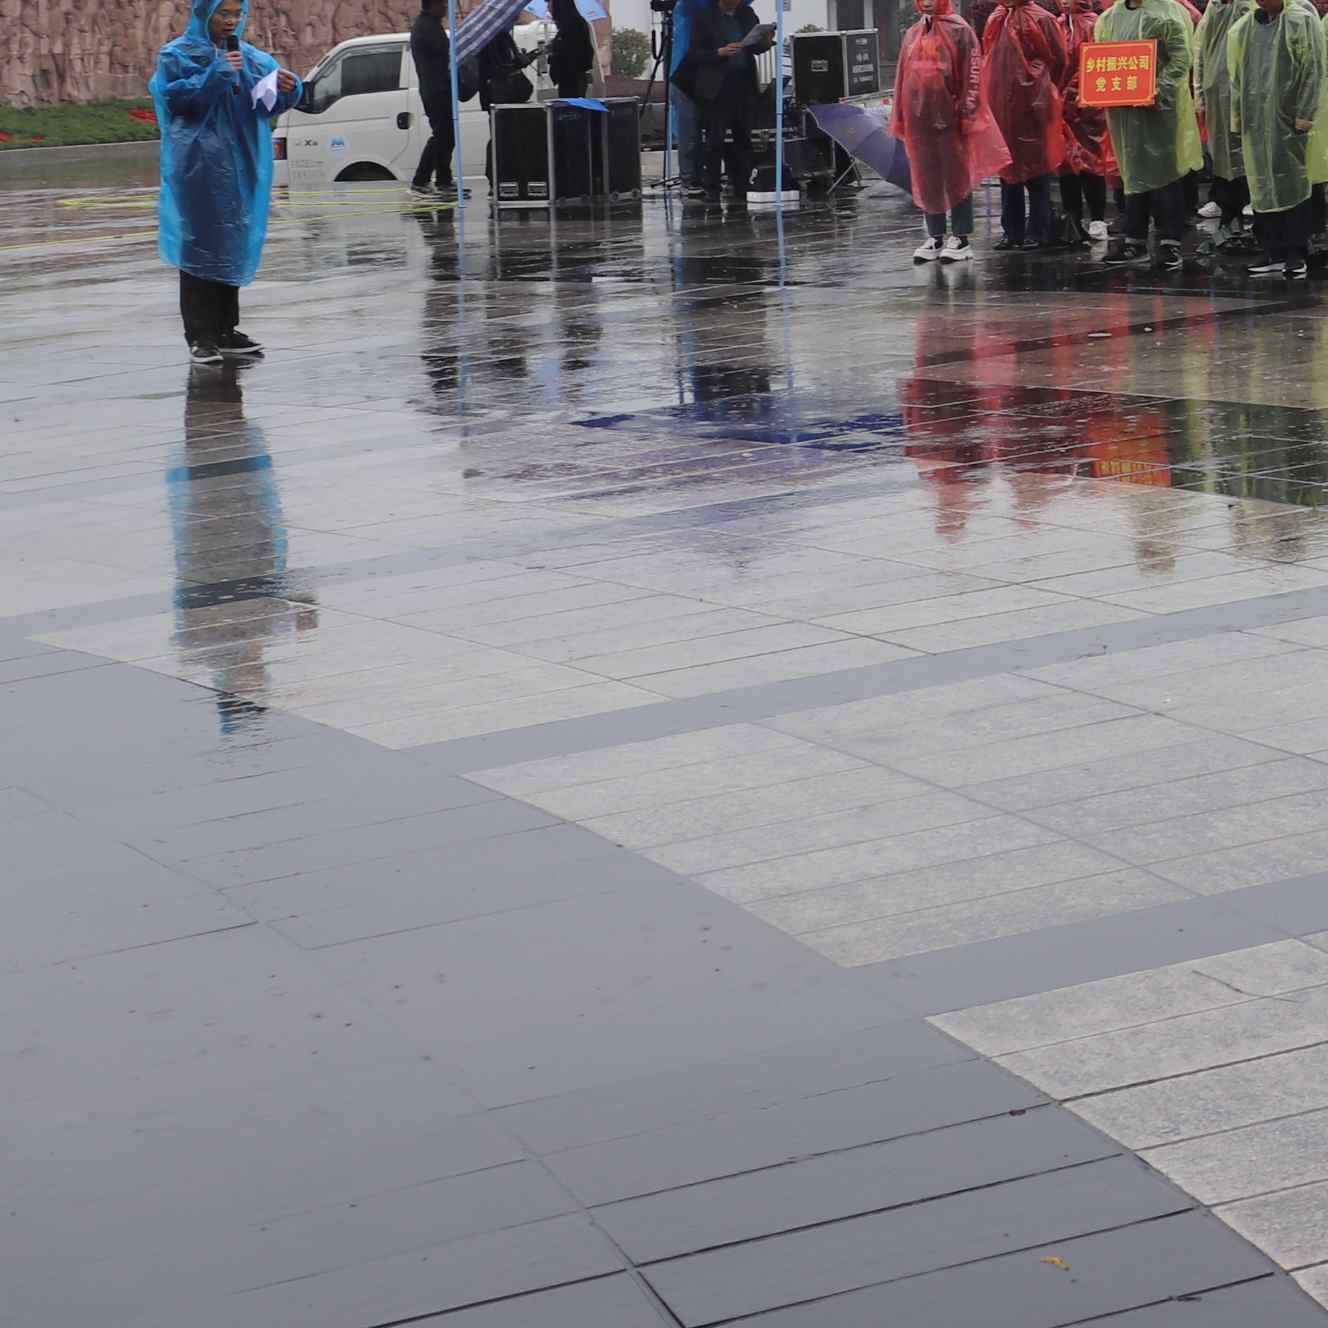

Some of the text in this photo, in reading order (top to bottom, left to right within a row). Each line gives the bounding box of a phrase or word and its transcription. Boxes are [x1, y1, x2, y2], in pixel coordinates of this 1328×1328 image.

[1086, 55, 1149, 73] 乡村振兴公司
